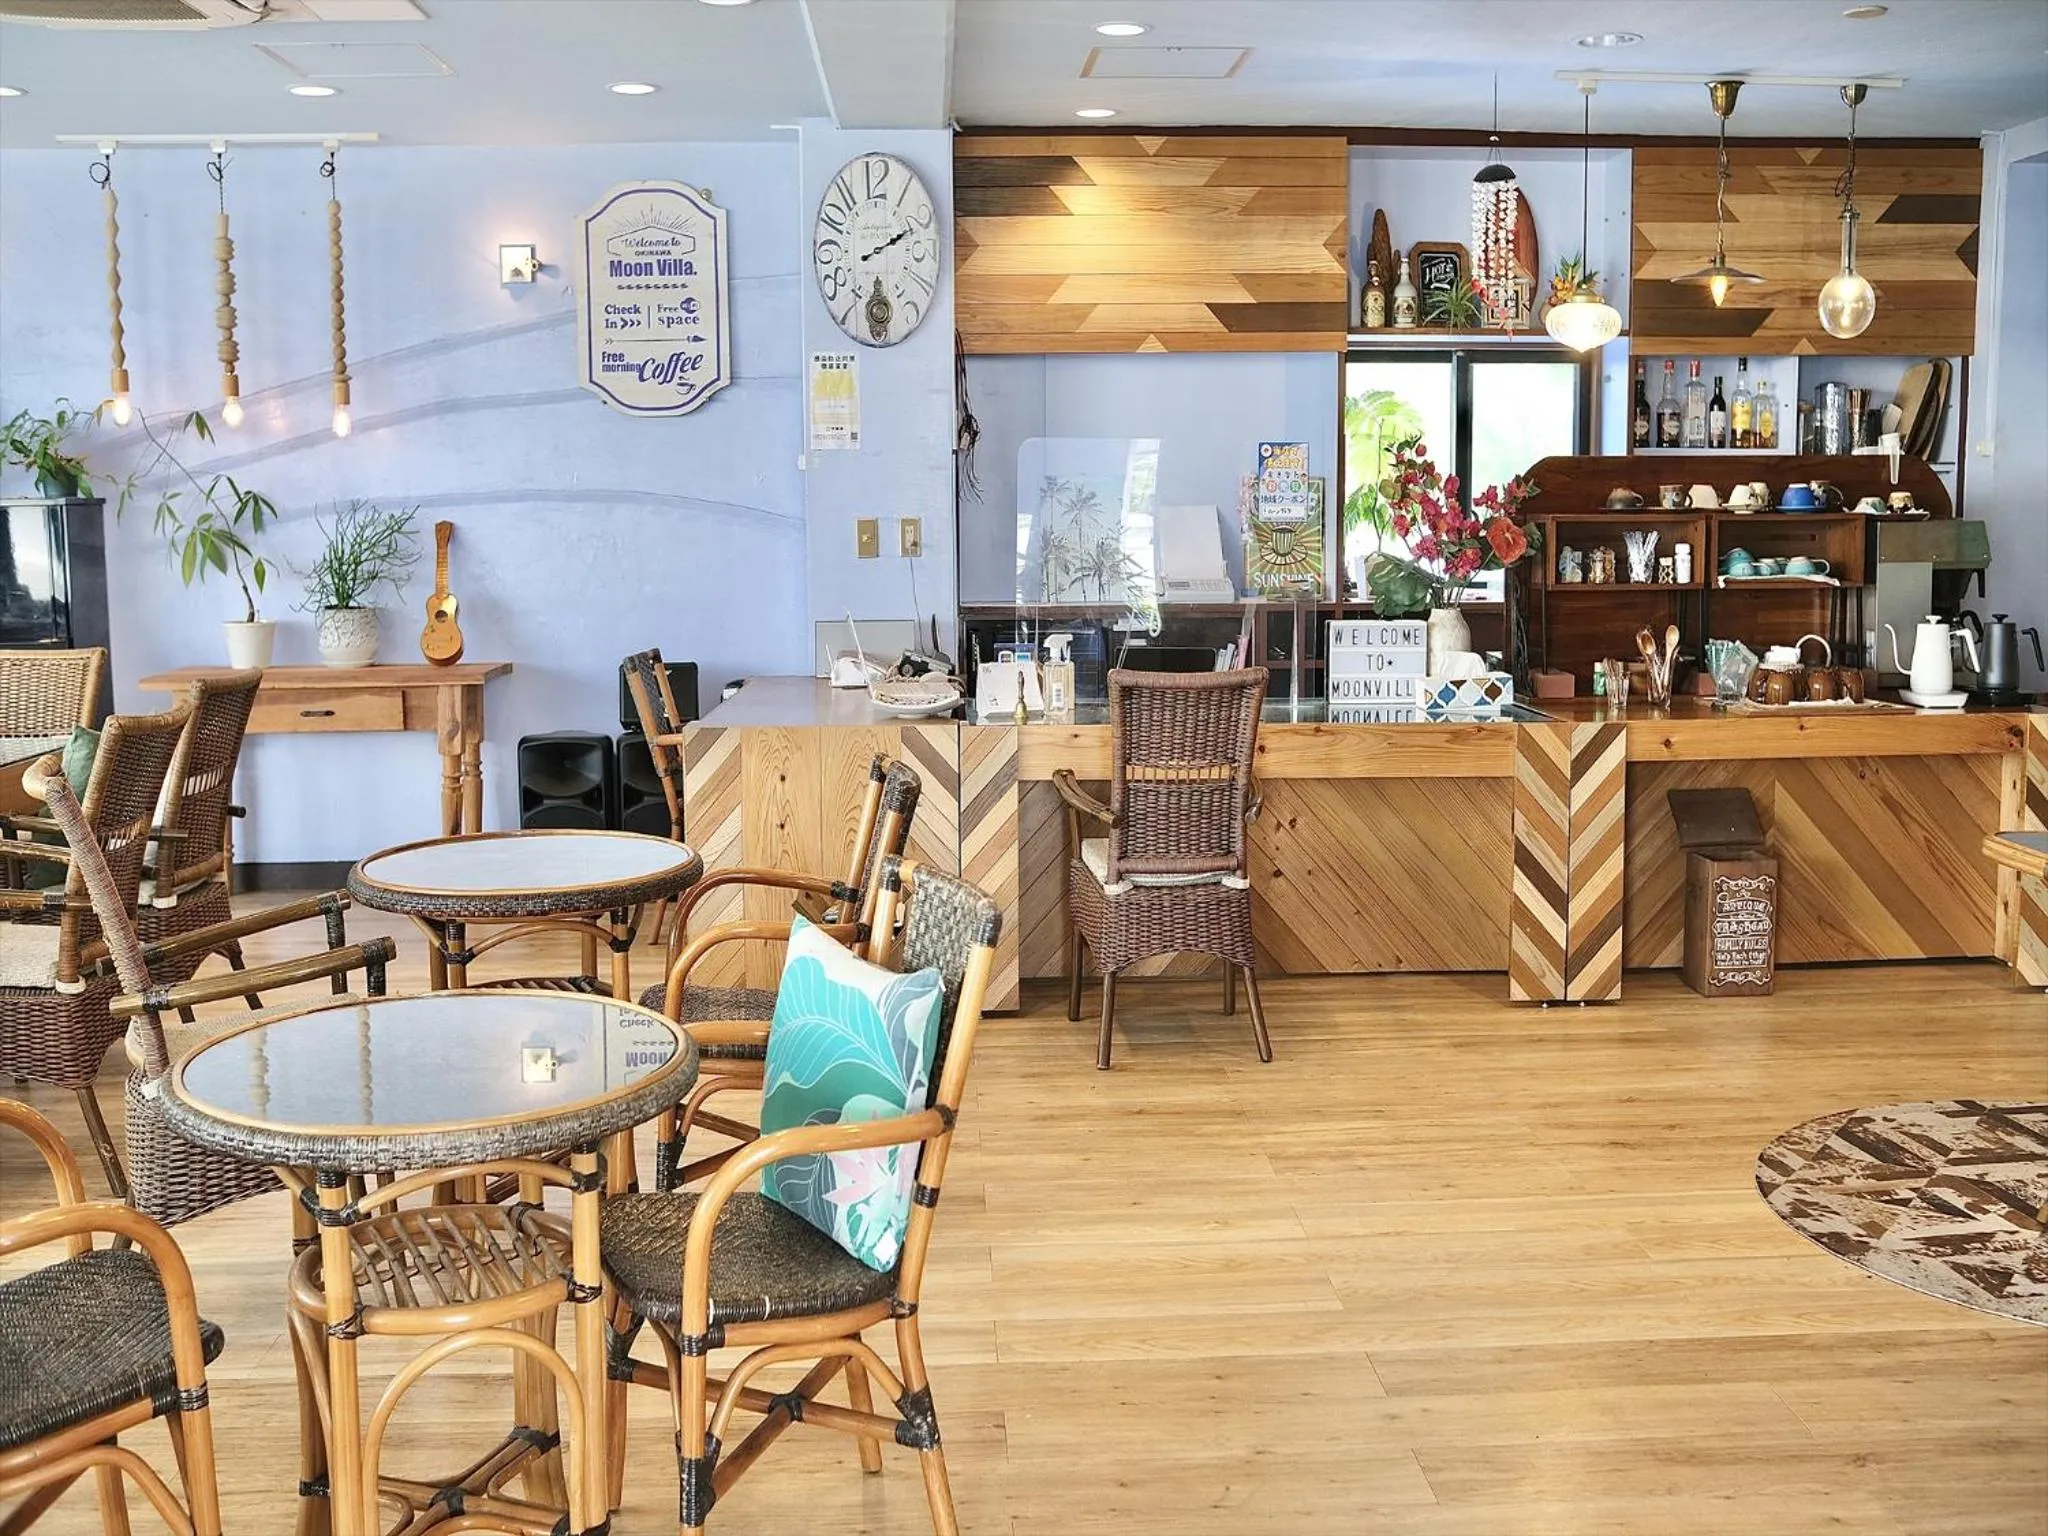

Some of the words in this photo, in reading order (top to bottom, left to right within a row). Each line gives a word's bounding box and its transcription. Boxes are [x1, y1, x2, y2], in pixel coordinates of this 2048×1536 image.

[864, 160, 890, 200] 12
[834, 175, 857, 212] 11
[896, 175, 913, 208] 1
[820, 203, 848, 236] 10
[905, 204, 932, 231] 2
[621, 236, 671, 249] Welcome
[671, 236, 682, 247] to
[817, 238, 843, 265] 9
[911, 238, 937, 264] 3
[609, 260, 653, 278] Moon
[656, 258, 698, 277] Villa.
[823, 266, 848, 301] 8
[604, 304, 642, 315] Check
[657, 303, 679, 313] Free
[604, 318, 618, 329] In
[657, 315, 700, 328] space
[601, 351, 625, 363] Free
[601, 362, 642, 373] morning
[638, 351, 704, 385] Coffee
[1260, 495, 1307, 505] 地域クーポン
[1254, 572, 1314, 588] SUNSHINE
[1334, 628, 1421, 646] WELCOME
[1366, 654, 1384, 672] TO
[1332, 679, 1413, 698] MOONVILL
[1722, 900, 1766, 912] ANTIQUE
